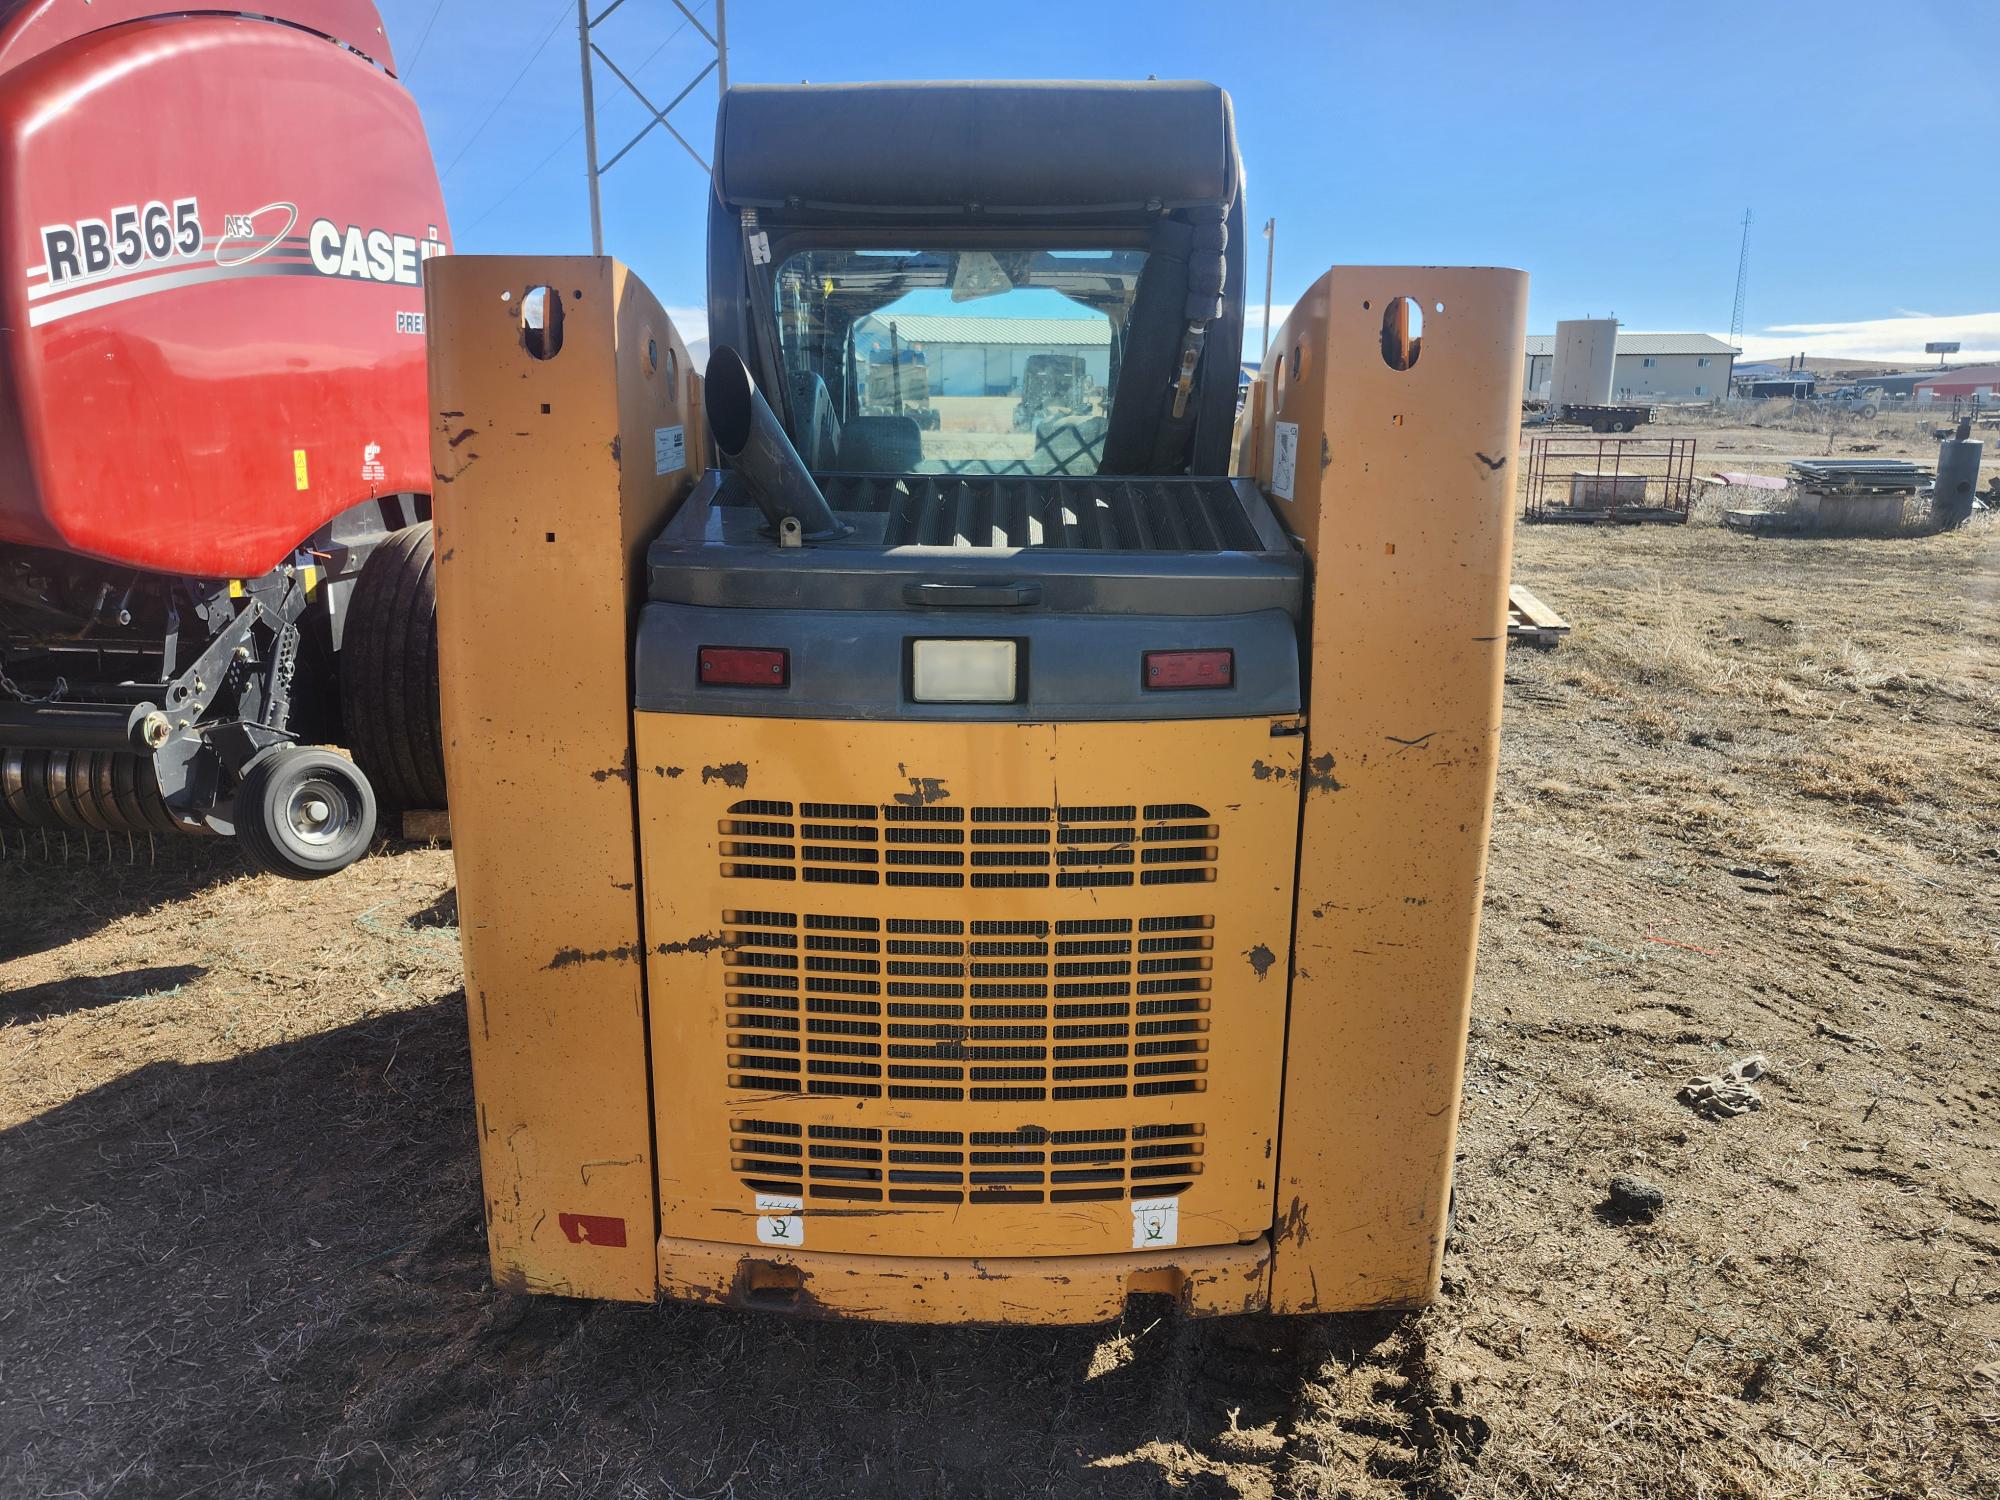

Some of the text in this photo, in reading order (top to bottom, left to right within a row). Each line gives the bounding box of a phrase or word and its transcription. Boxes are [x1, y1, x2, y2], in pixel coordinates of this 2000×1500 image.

[42, 198, 202, 285] RB565
[225, 215, 253, 237] AFS
[309, 219, 417, 284] CASE
[397, 311, 425, 334] PRE
